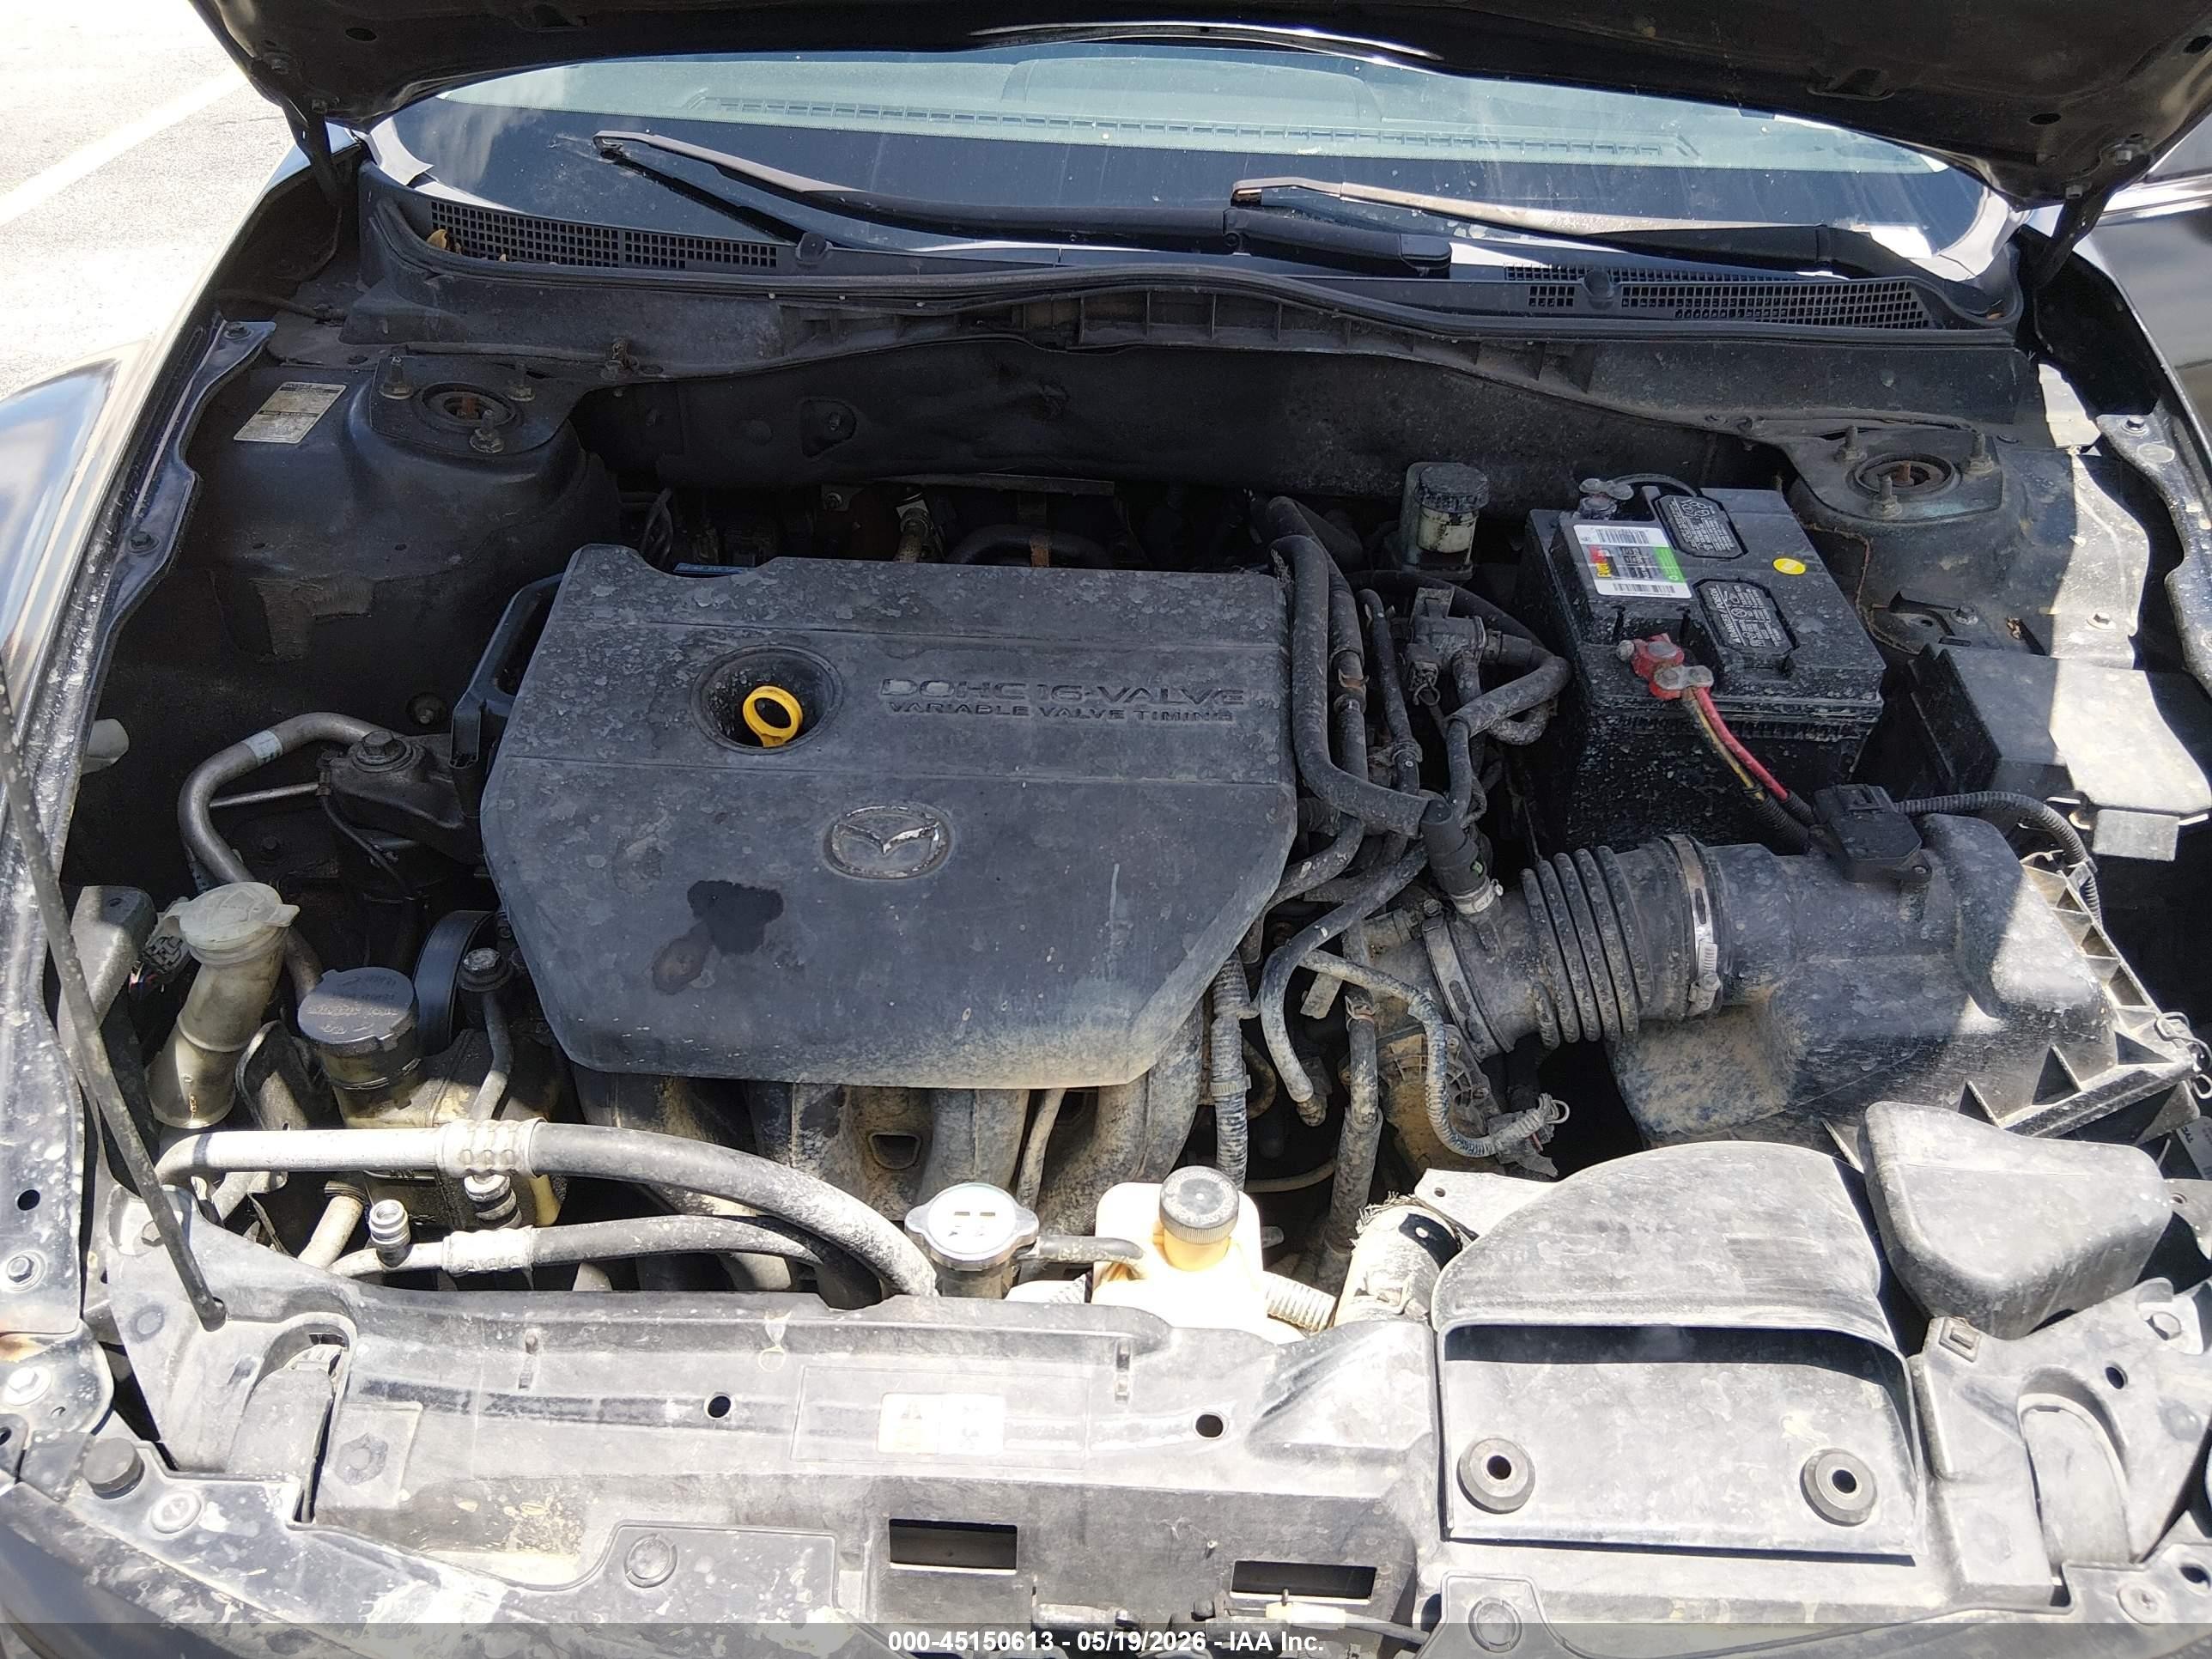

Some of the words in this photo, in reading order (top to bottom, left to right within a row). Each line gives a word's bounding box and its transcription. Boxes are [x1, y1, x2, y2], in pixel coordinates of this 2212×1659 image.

[881, 678, 1028, 699] DOHC
[889, 702, 1030, 716] VARIABLE
[1038, 707, 1126, 720] VALVE
[1133, 709, 1233, 722] TIMING
